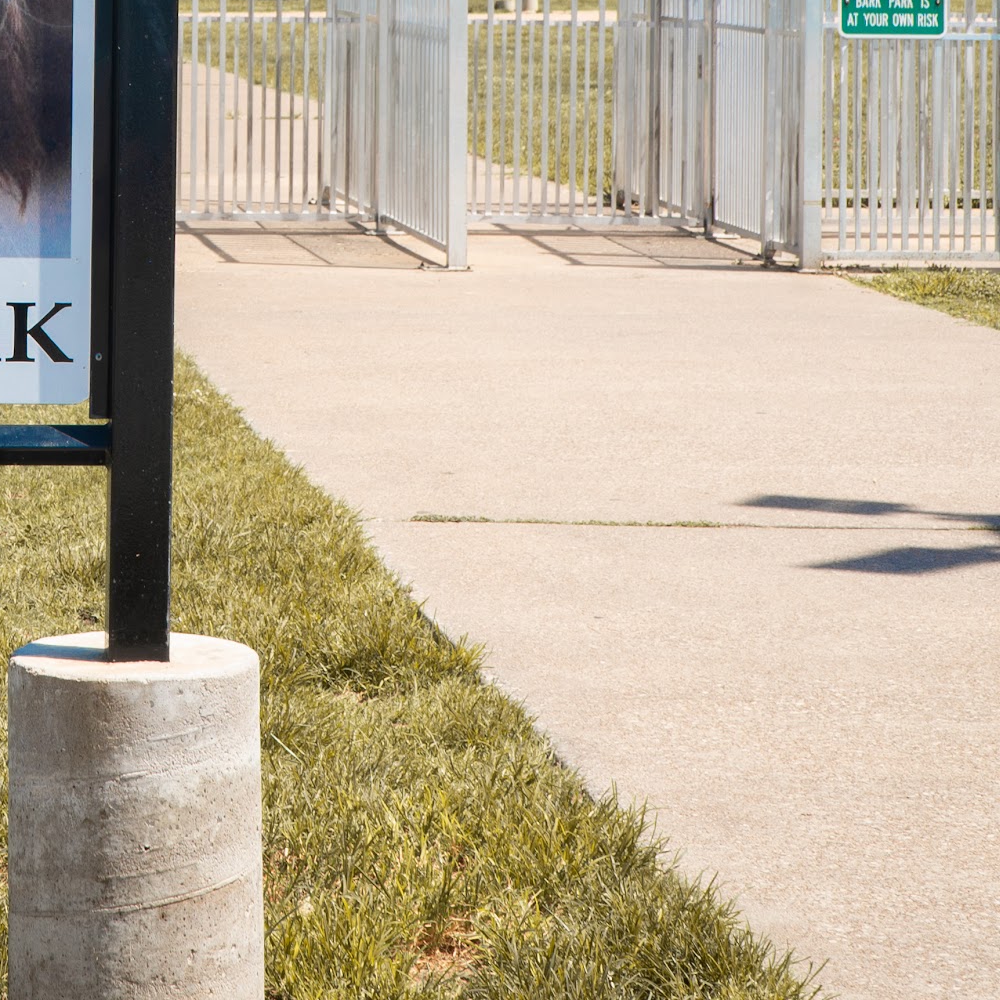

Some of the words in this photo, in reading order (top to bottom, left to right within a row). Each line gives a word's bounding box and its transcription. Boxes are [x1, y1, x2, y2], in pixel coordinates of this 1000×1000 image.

[847, 13, 858, 27] AT
[863, 13, 888, 27] YOUR
[892, 13, 914, 27] OWN
[917, 13, 939, 27] RISK
